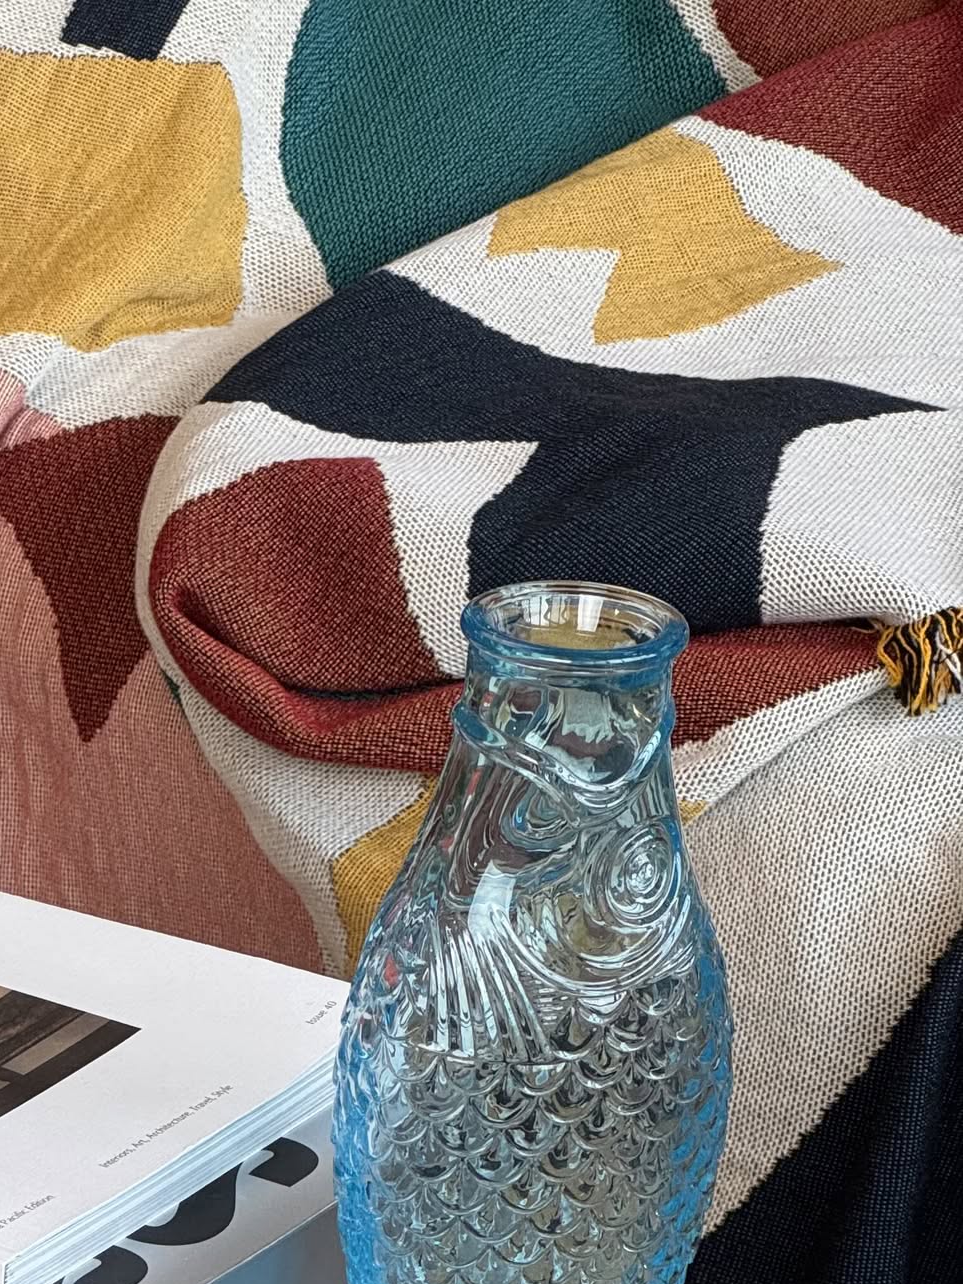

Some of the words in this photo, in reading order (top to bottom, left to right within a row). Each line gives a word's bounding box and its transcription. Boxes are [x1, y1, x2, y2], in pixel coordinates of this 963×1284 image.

[98, 1147, 135, 1169] Interiors,
[131, 1138, 151, 1149] Art,
[146, 1111, 196, 1140] Architecture,
[188, 1095, 217, 1112] Travel,
[210, 1084, 234, 1098] Style
[0, 1209, 29, 1226] Pacific
[24, 1194, 56, 1211] Edition
